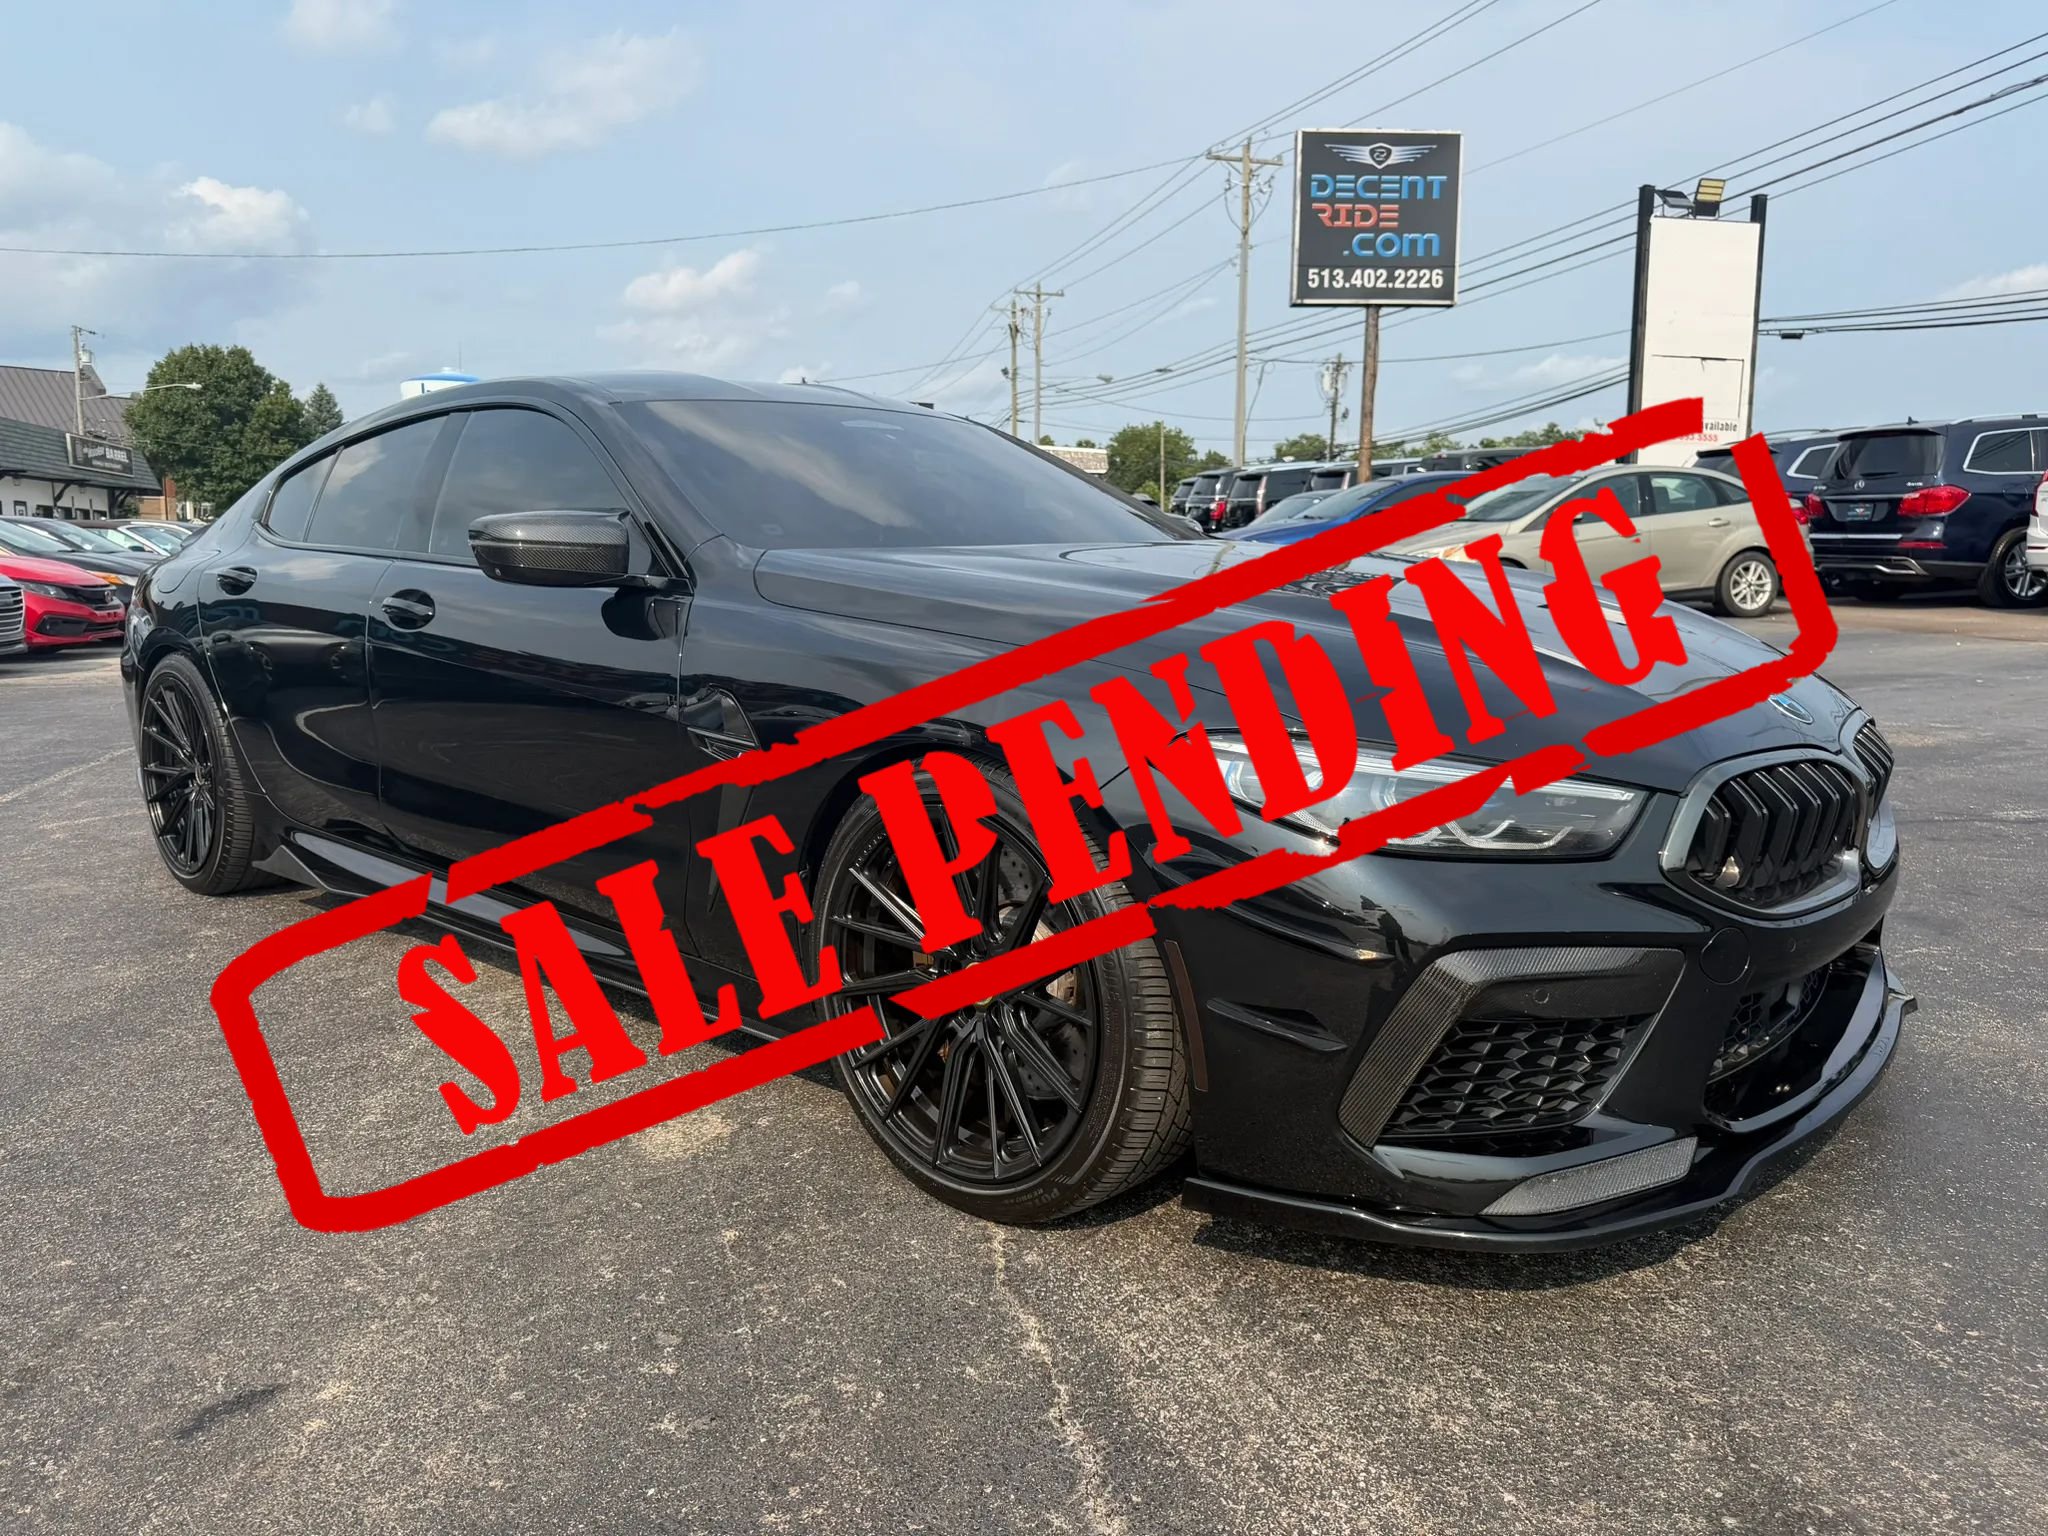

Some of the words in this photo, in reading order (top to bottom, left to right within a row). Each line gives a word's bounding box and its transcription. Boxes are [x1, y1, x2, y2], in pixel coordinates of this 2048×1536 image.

[1310, 173, 1448, 200] DECENT
[1311, 203, 1400, 228] RIDE
[1307, 268, 1444, 289] 513.402.2226
[1703, 421, 1738, 432] vailable
